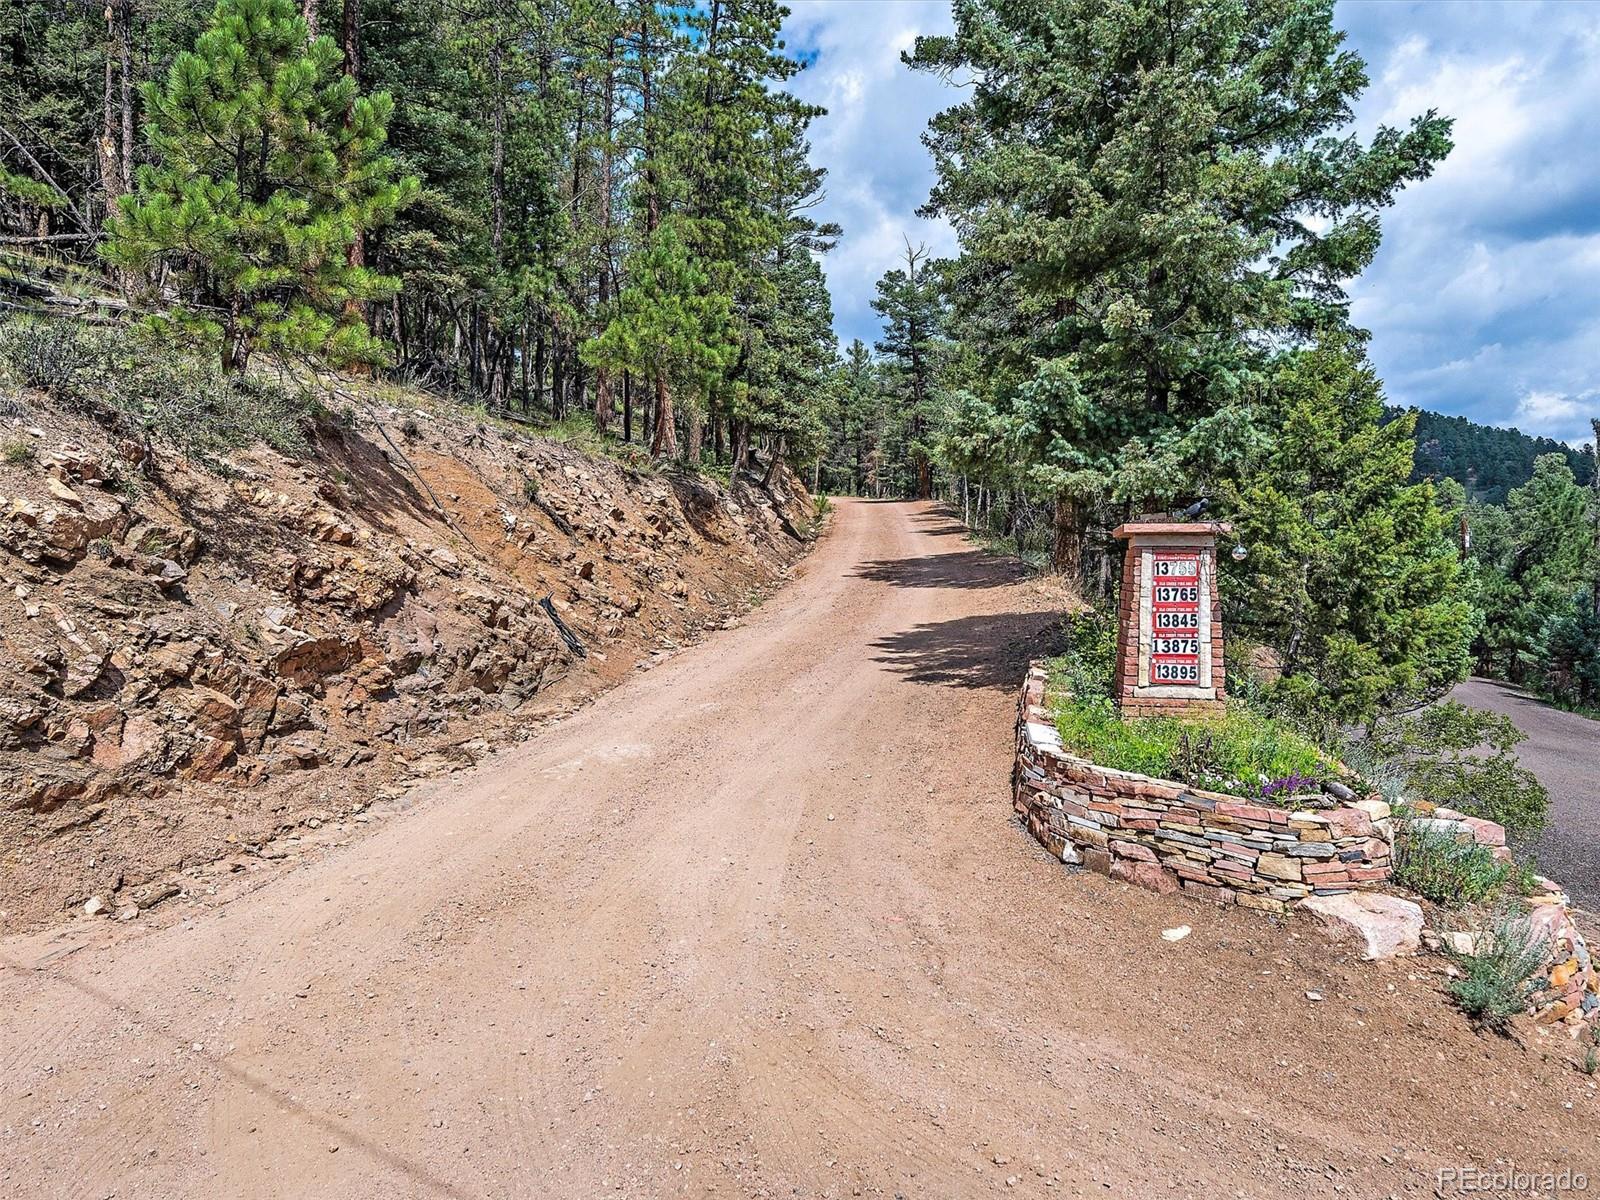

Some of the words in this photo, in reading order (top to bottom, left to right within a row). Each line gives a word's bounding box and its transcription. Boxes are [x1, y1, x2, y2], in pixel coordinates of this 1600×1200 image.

[1155, 562, 1196, 575] 13755
[1156, 588, 1197, 601] 13765
[1157, 614, 1197, 627] 13845
[1153, 640, 1198, 653] 13875
[1157, 665, 1197, 679] 13895
